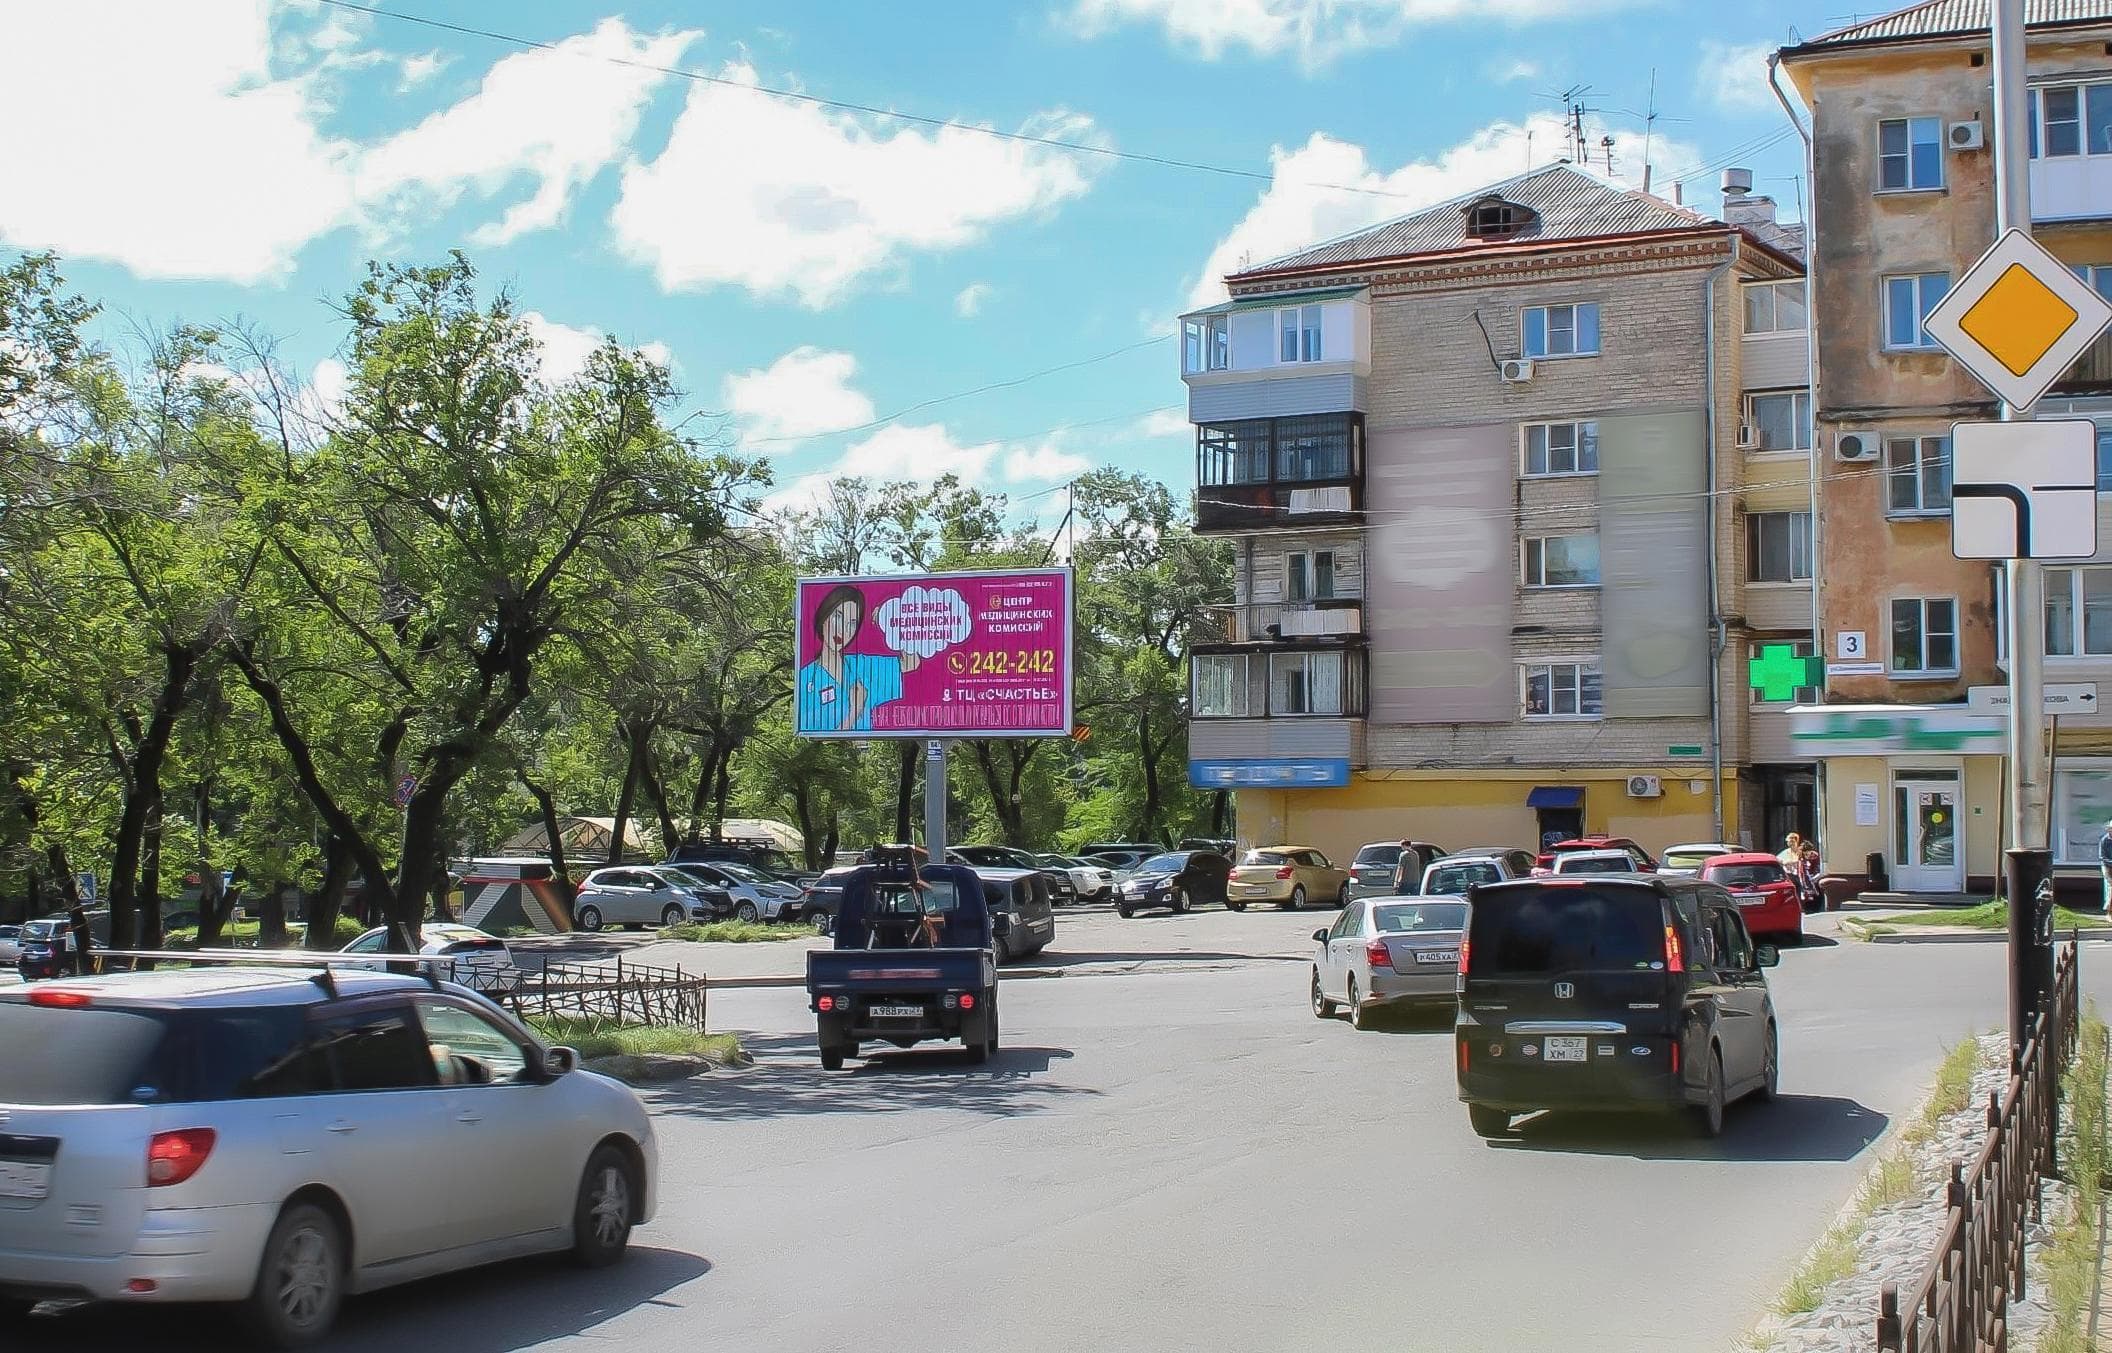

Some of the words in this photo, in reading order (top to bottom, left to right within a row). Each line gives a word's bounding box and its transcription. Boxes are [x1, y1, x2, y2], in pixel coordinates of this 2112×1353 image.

[901, 603, 919, 613] ВСЕ
[922, 602, 952, 613] ВИДЫ
[889, 615, 962, 628] МЕДИЦИНСКИХ
[979, 609, 1054, 621] МЕДИЦИНСКИХ
[1846, 636, 1857, 652] 3
[969, 650, 1054, 674] 242-242
[957, 689, 975, 702] ТЦ
